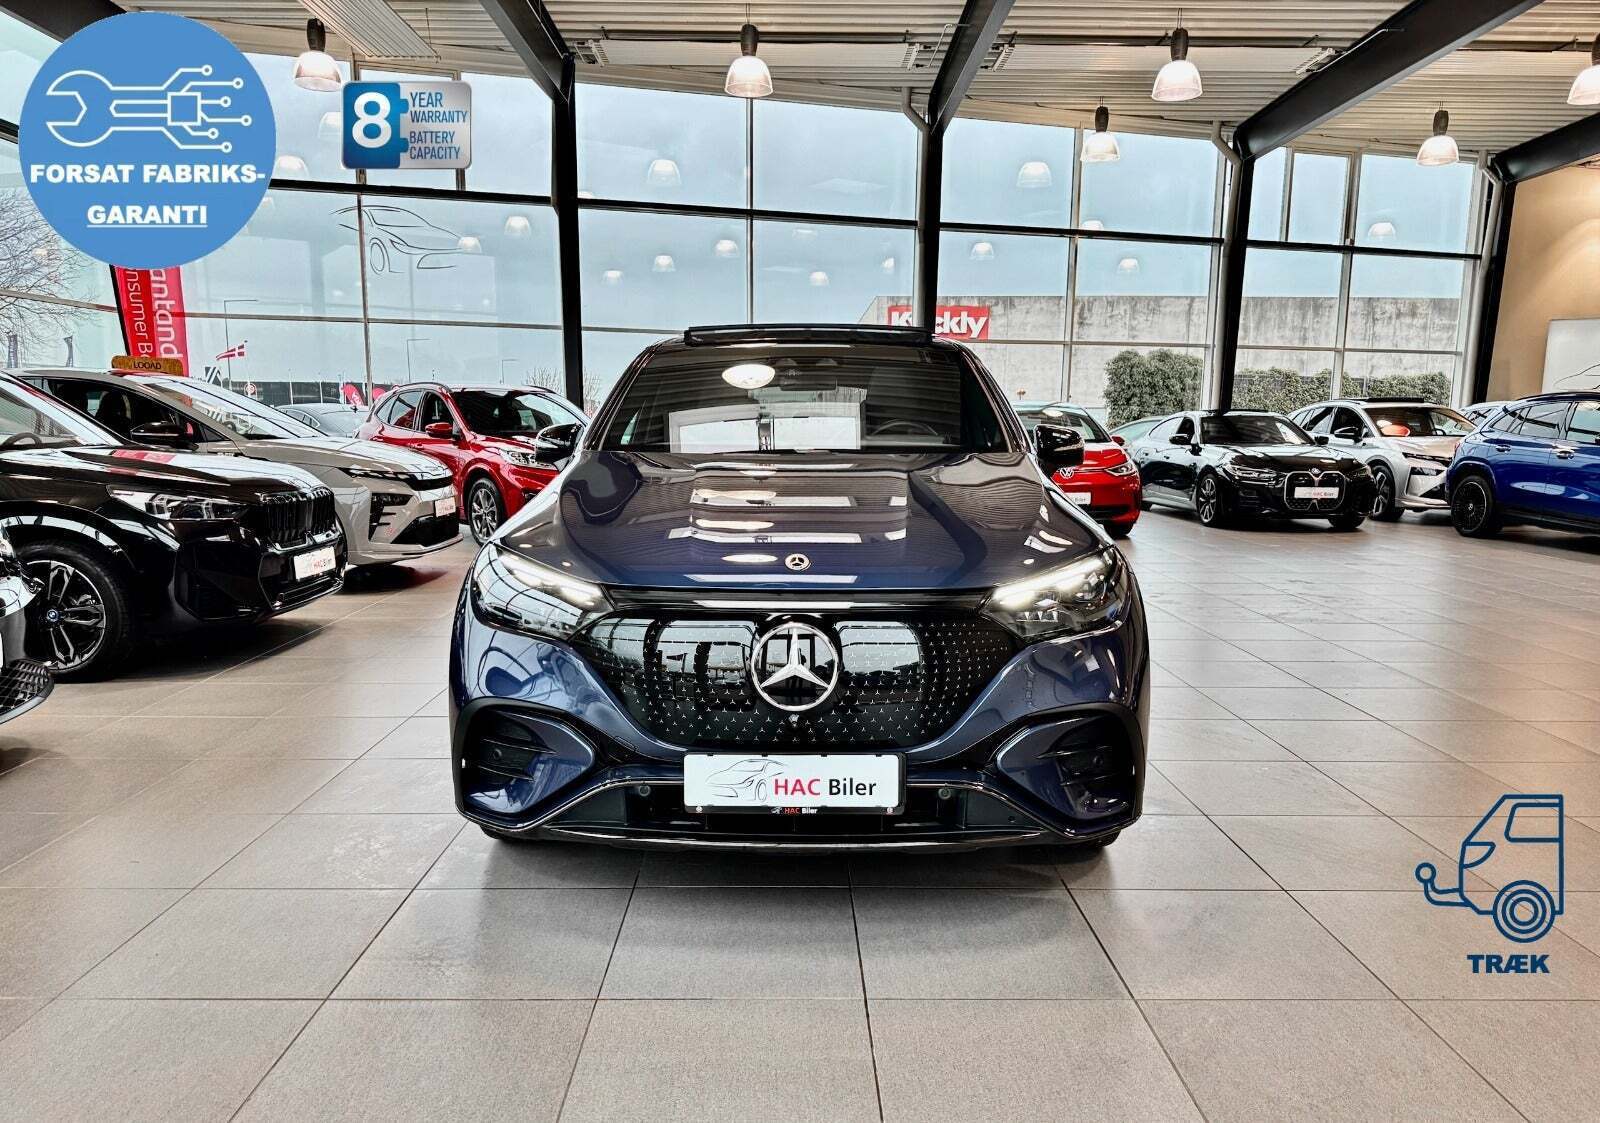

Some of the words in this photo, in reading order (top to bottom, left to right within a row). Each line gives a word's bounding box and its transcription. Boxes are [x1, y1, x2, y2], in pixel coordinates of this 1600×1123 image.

[774, 778, 821, 796] HAC
[828, 777, 877, 796] Biler
[784, 807, 801, 815] HAC
[801, 807, 818, 815] Biler
